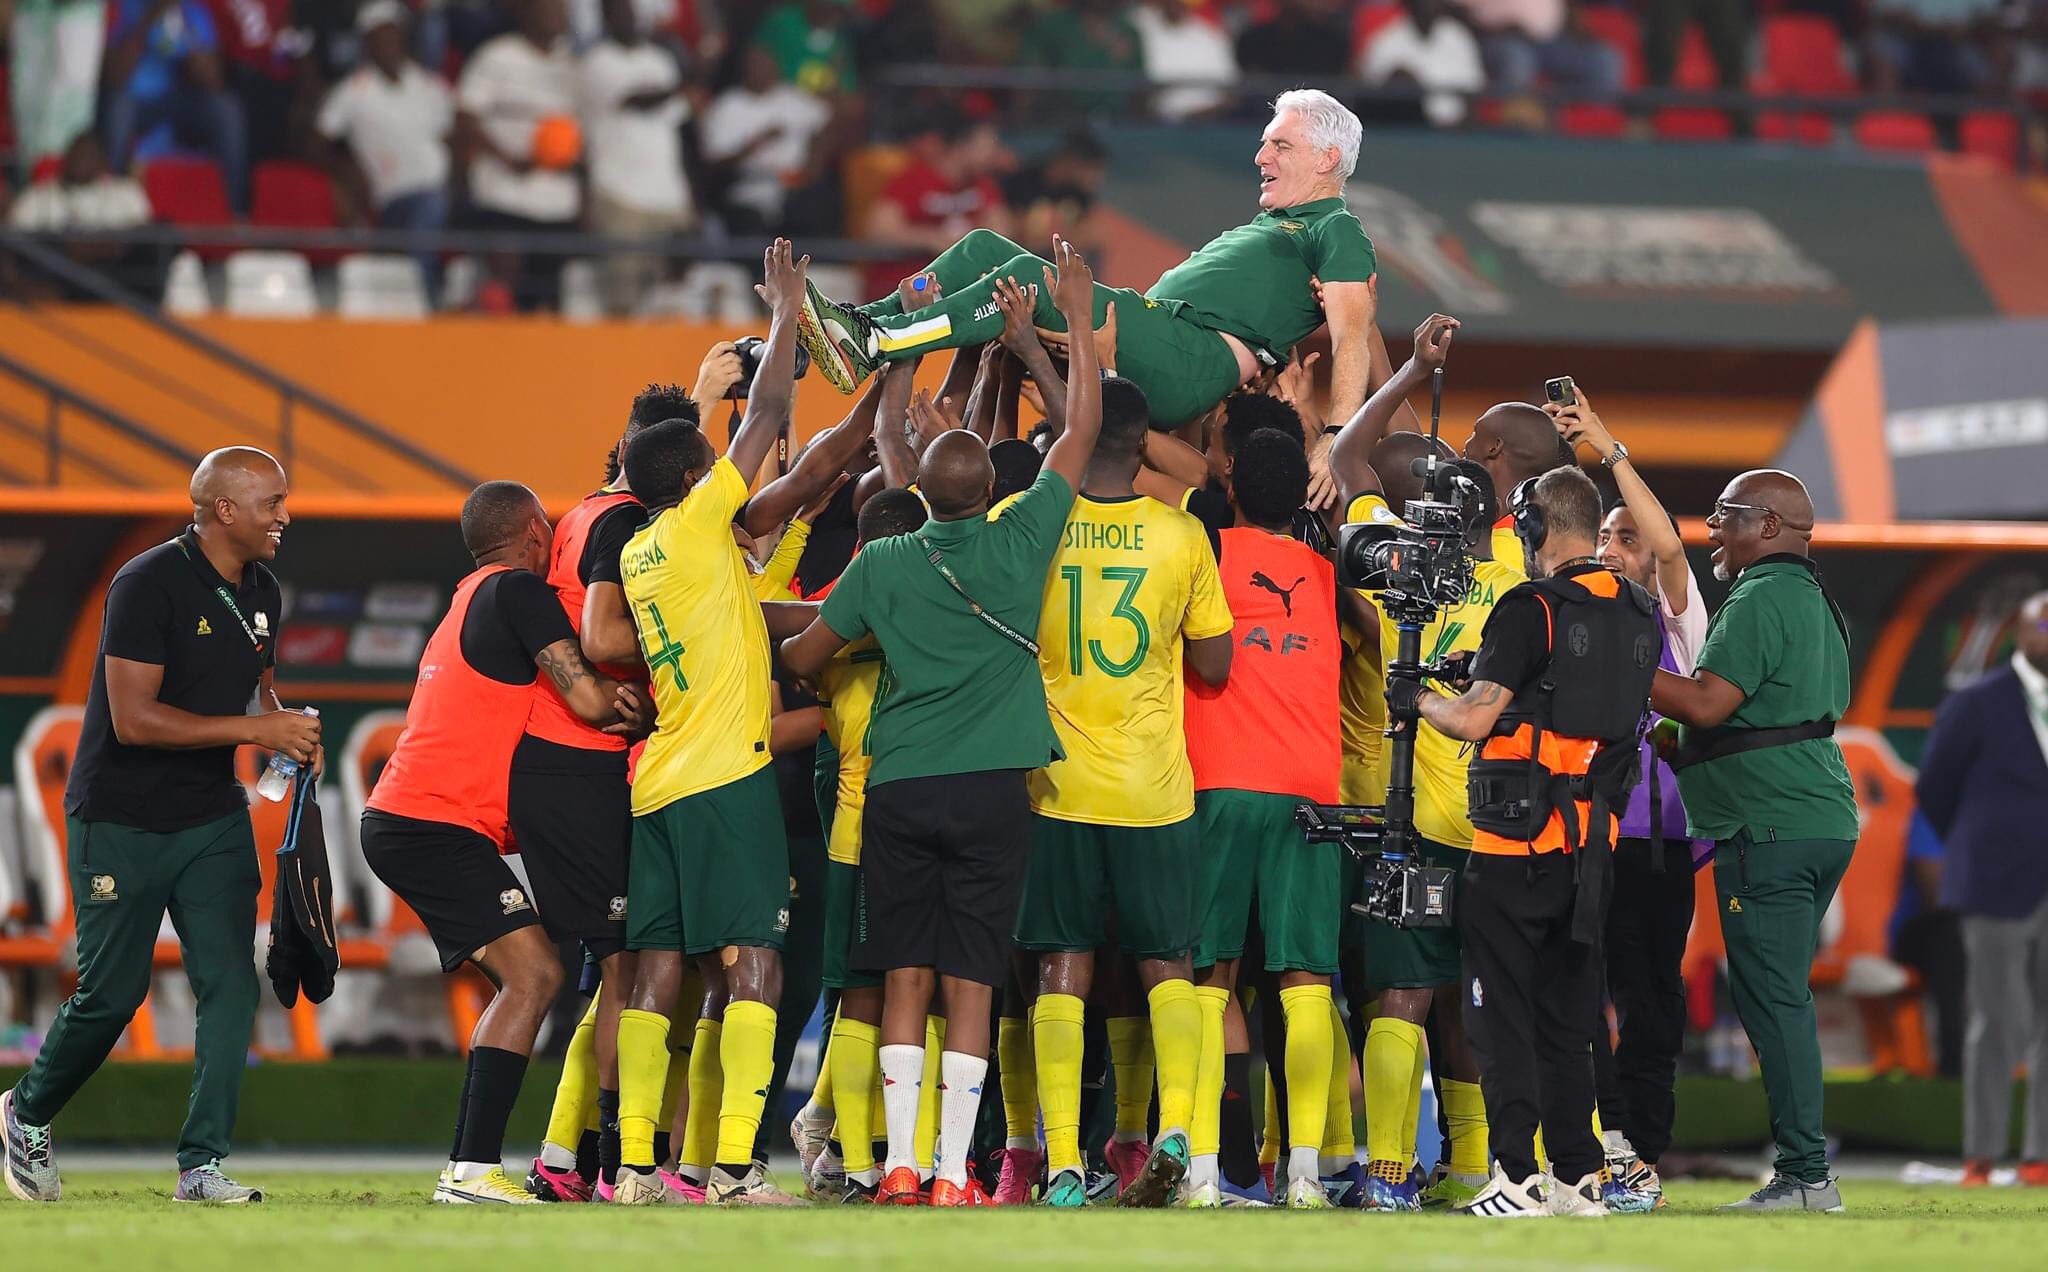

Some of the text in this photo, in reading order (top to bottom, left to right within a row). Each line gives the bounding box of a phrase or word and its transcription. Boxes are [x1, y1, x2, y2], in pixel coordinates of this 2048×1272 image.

[1064, 521, 1144, 551] SITHOLE
[622, 542, 667, 585] KOENA
[980, 611, 1001, 628] NATIONS
[1006, 629, 1016, 638] CUP
[1061, 565, 1150, 678] 13
[633, 601, 690, 692] 4
